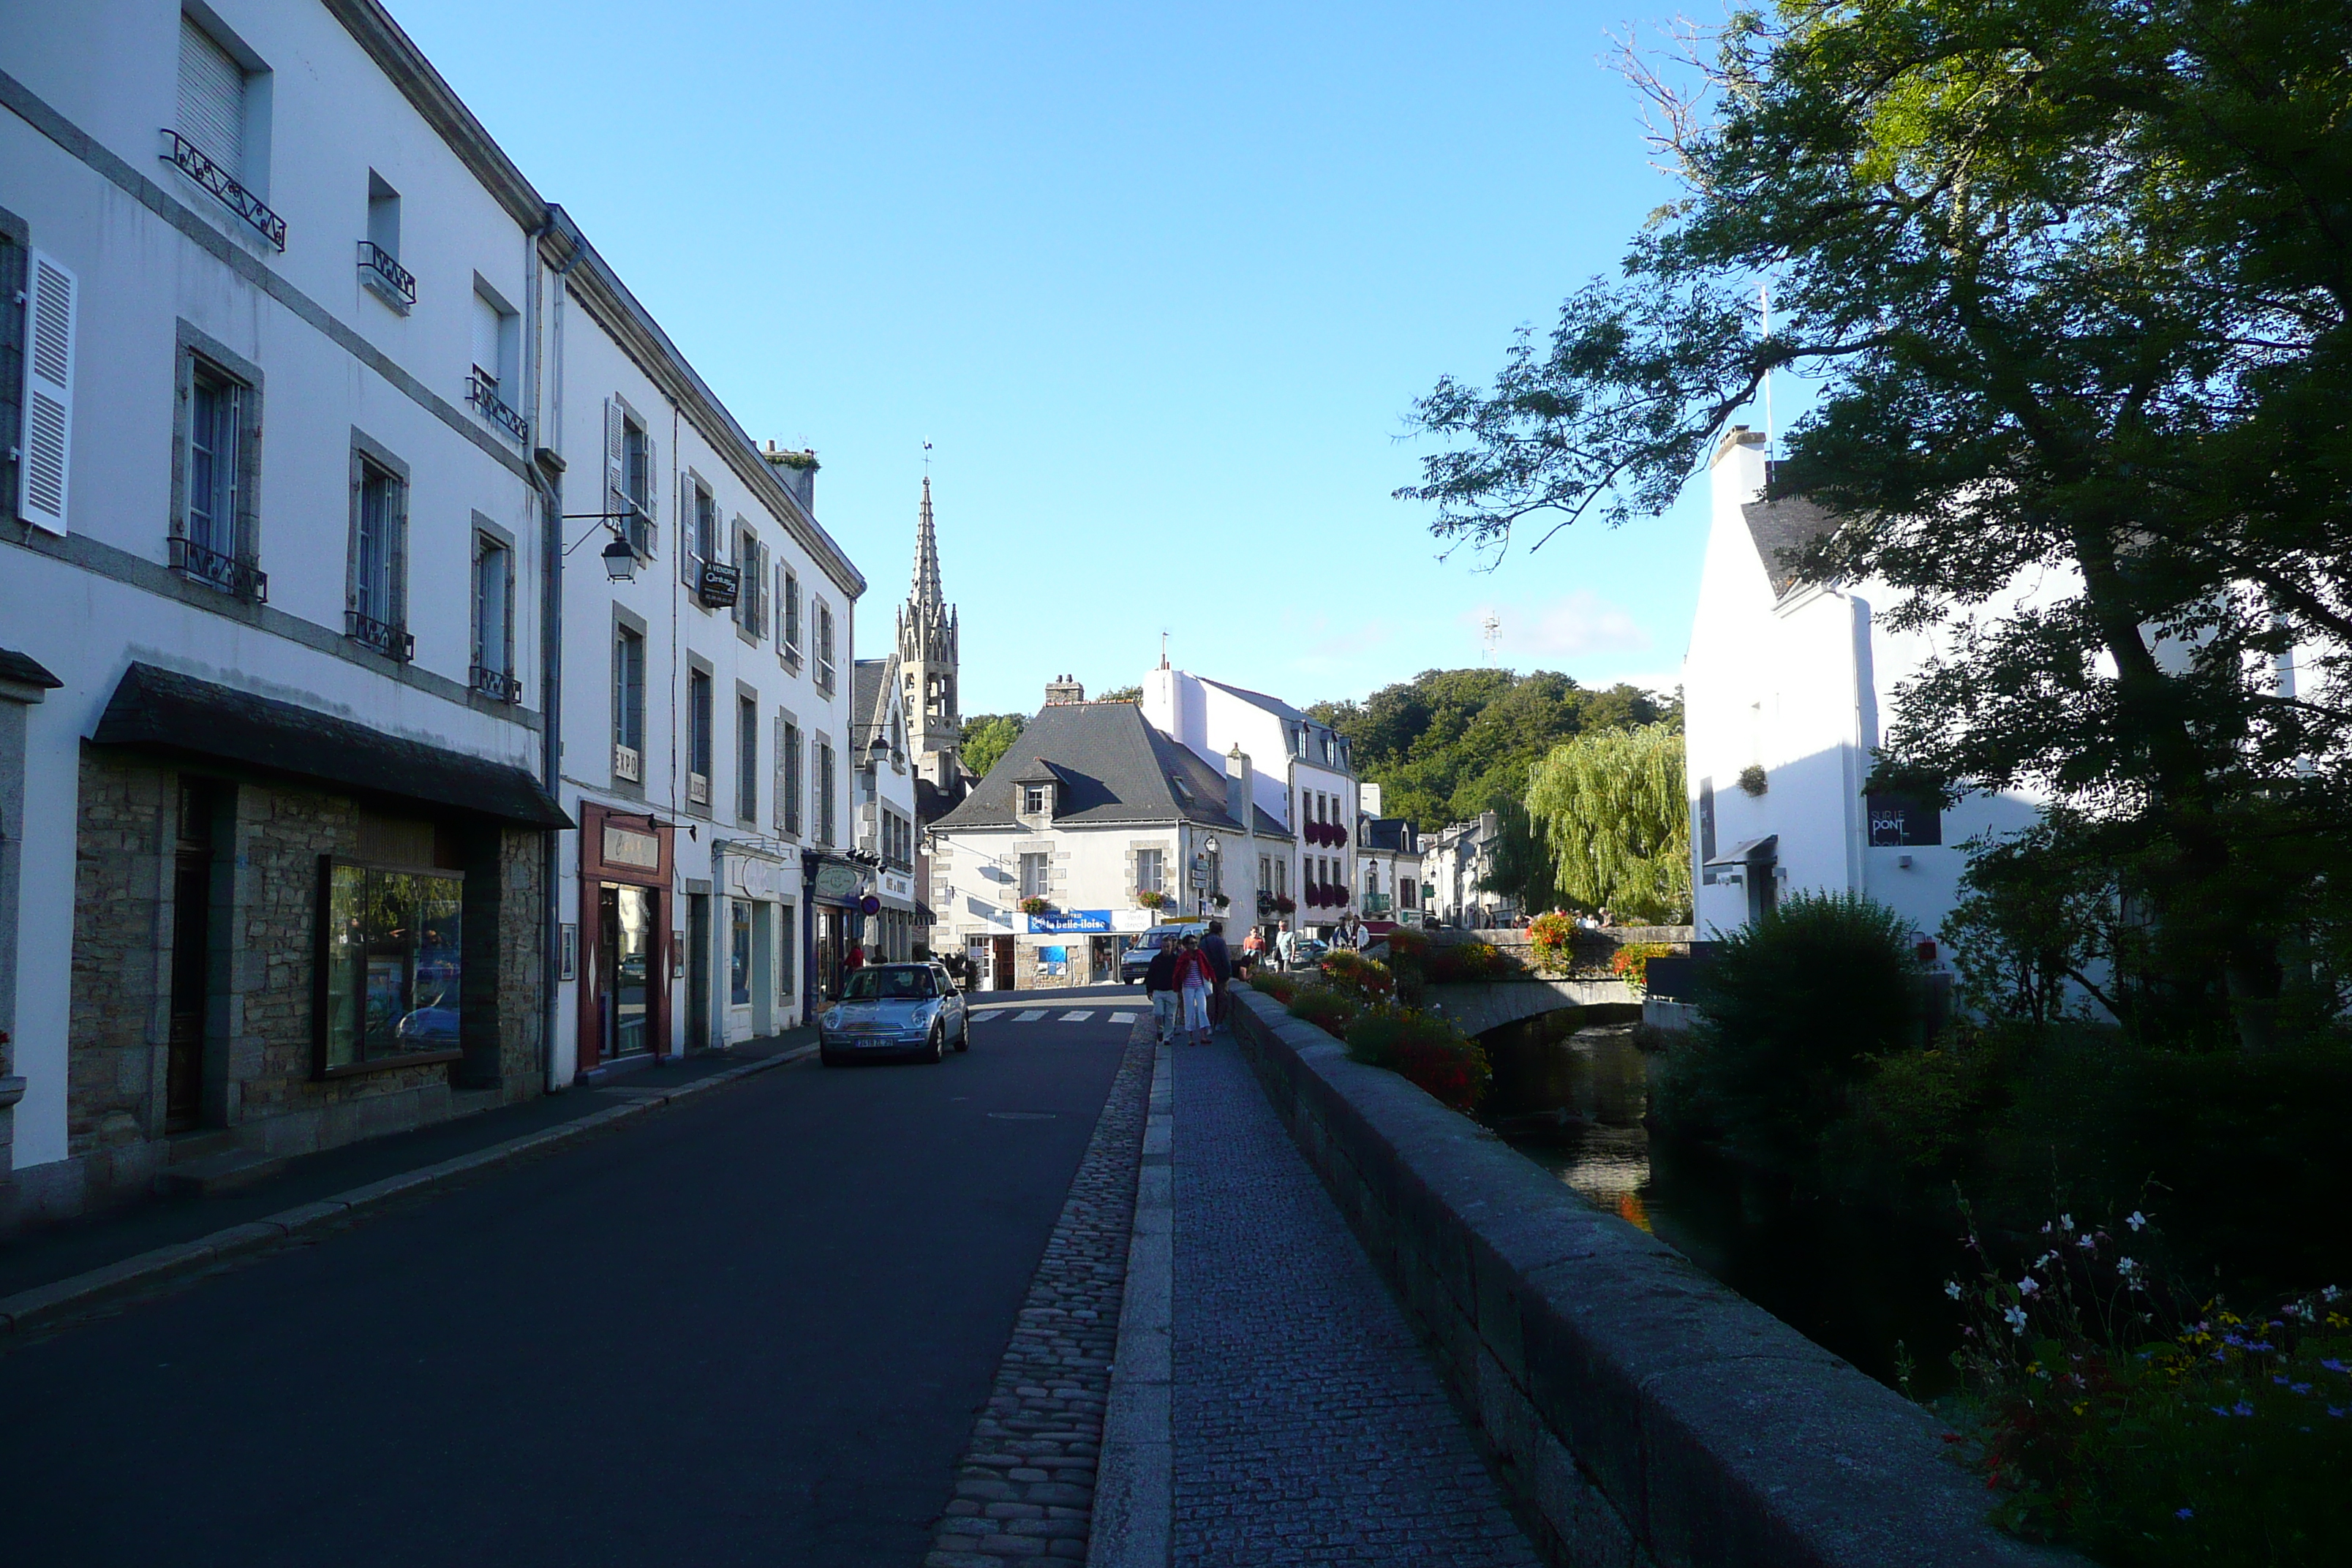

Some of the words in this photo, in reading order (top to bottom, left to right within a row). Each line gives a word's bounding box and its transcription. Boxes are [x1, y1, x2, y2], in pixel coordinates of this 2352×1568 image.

[712, 565, 736, 577] VENDRE
[727, 583, 736, 592] 21
[616, 751, 636, 774] EXPO
[1872, 810, 1892, 821] SUR
[1894, 810, 1905, 820] LE
[1872, 819, 1904, 836] PONT
[1046, 920, 1055, 929] la
